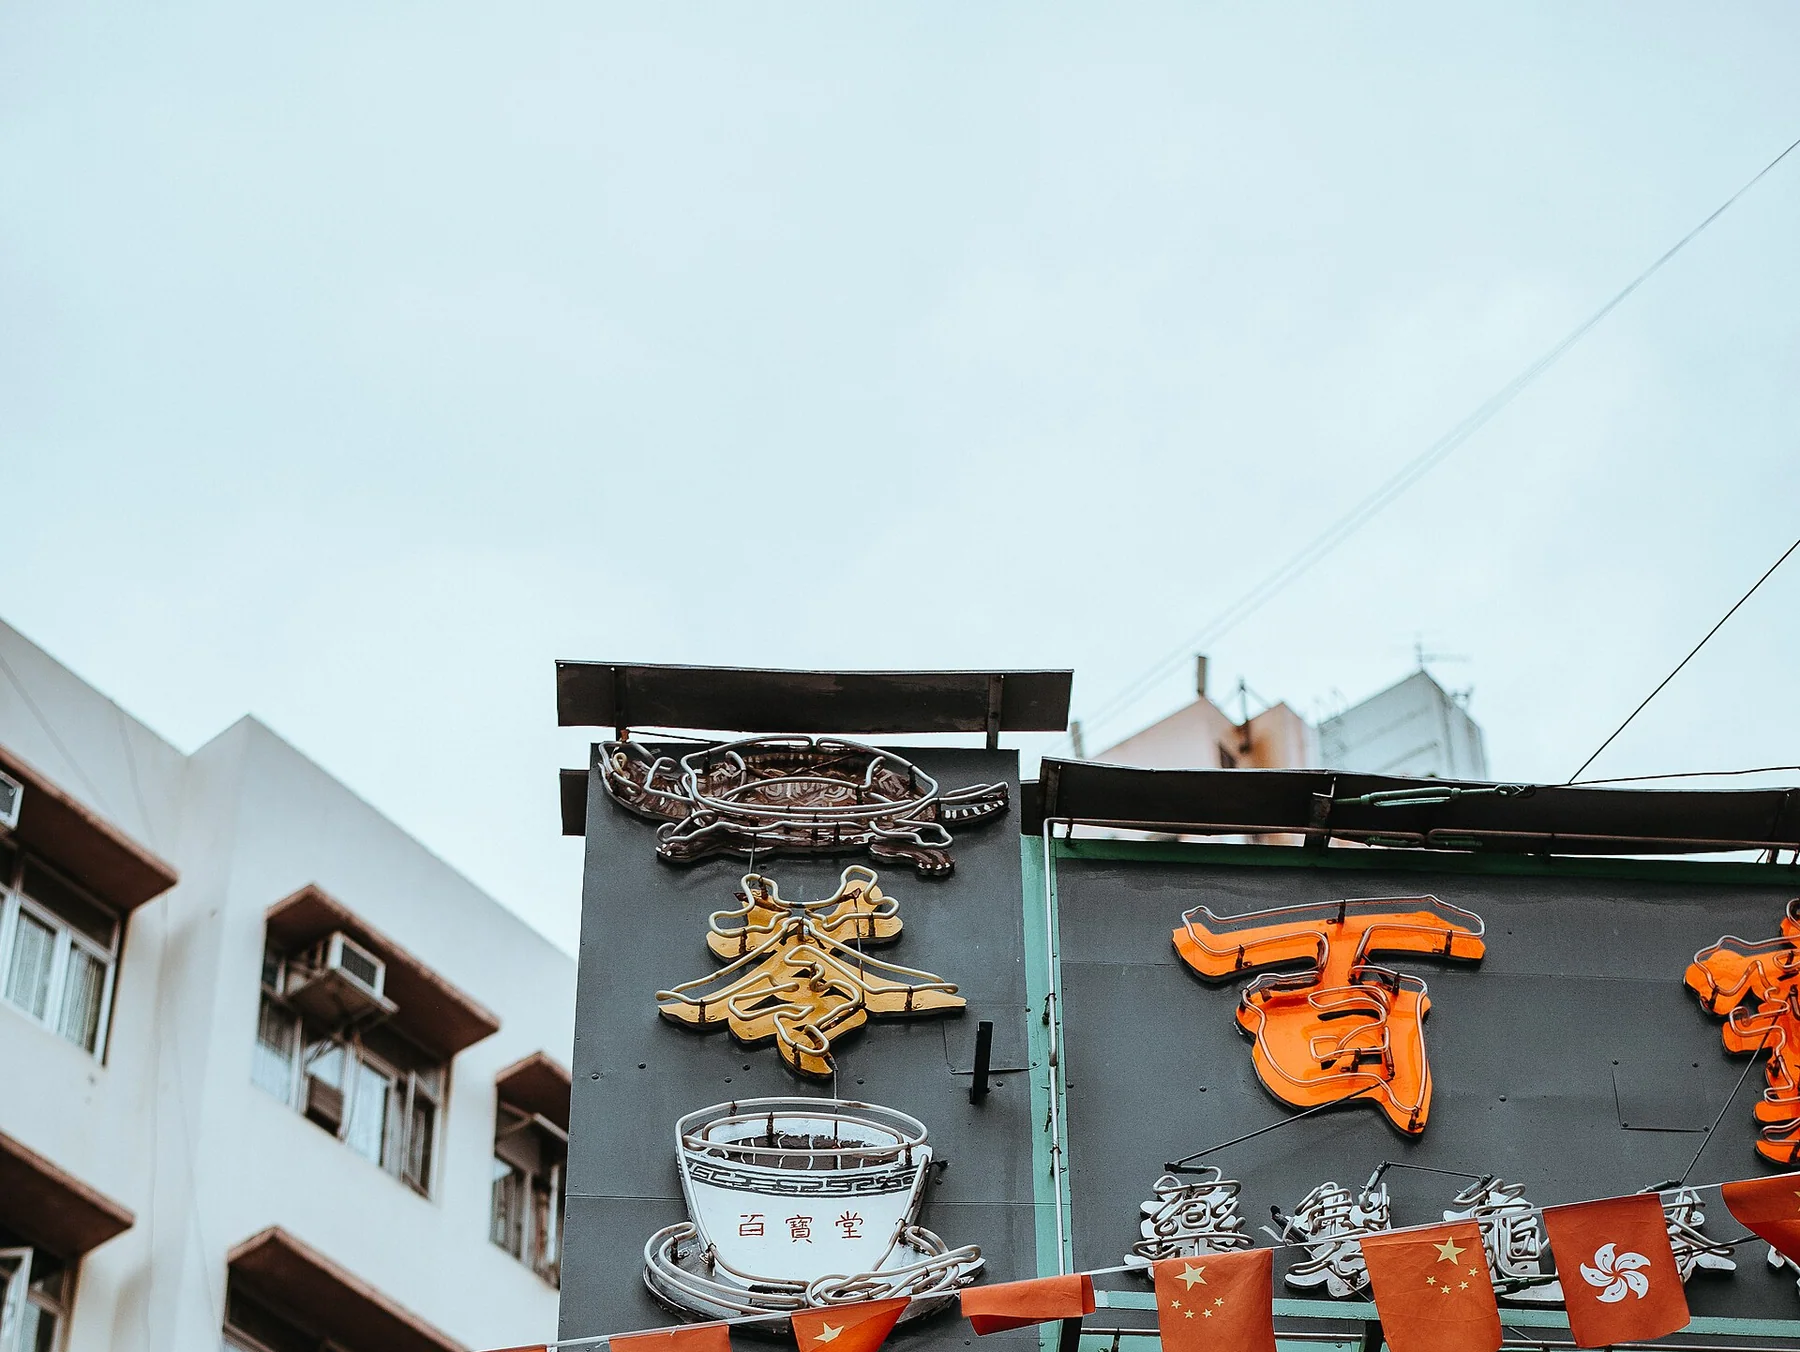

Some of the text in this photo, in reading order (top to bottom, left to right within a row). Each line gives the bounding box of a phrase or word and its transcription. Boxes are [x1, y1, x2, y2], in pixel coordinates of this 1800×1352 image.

[655, 864, 967, 1077] 苓
[738, 1210, 865, 1245] 百寶堂
